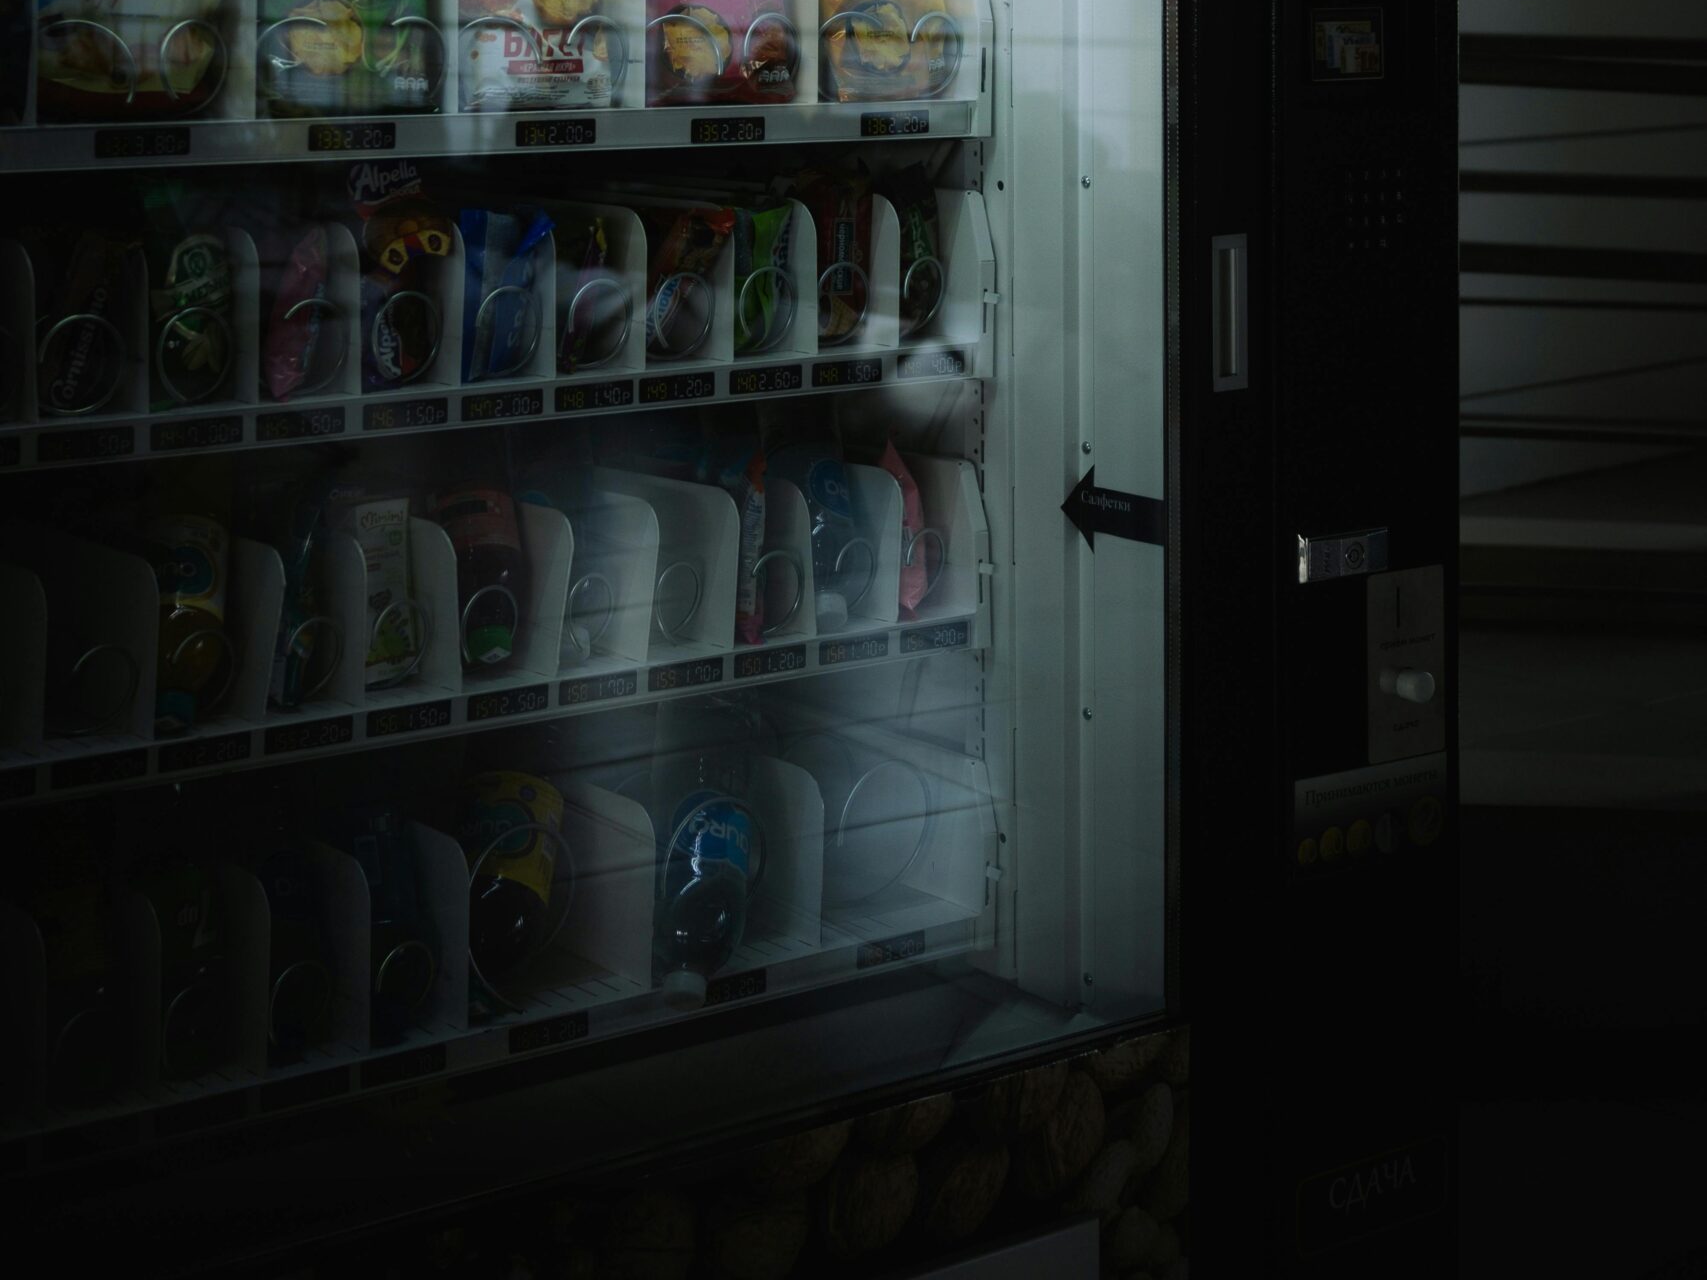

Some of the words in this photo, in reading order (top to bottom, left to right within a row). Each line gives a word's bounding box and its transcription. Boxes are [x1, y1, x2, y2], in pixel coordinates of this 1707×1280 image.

[353, 160, 419, 201] Alpella
[1081, 489, 1133, 512] Салфетки
[1328, 1152, 1417, 1217] СДАЧА
